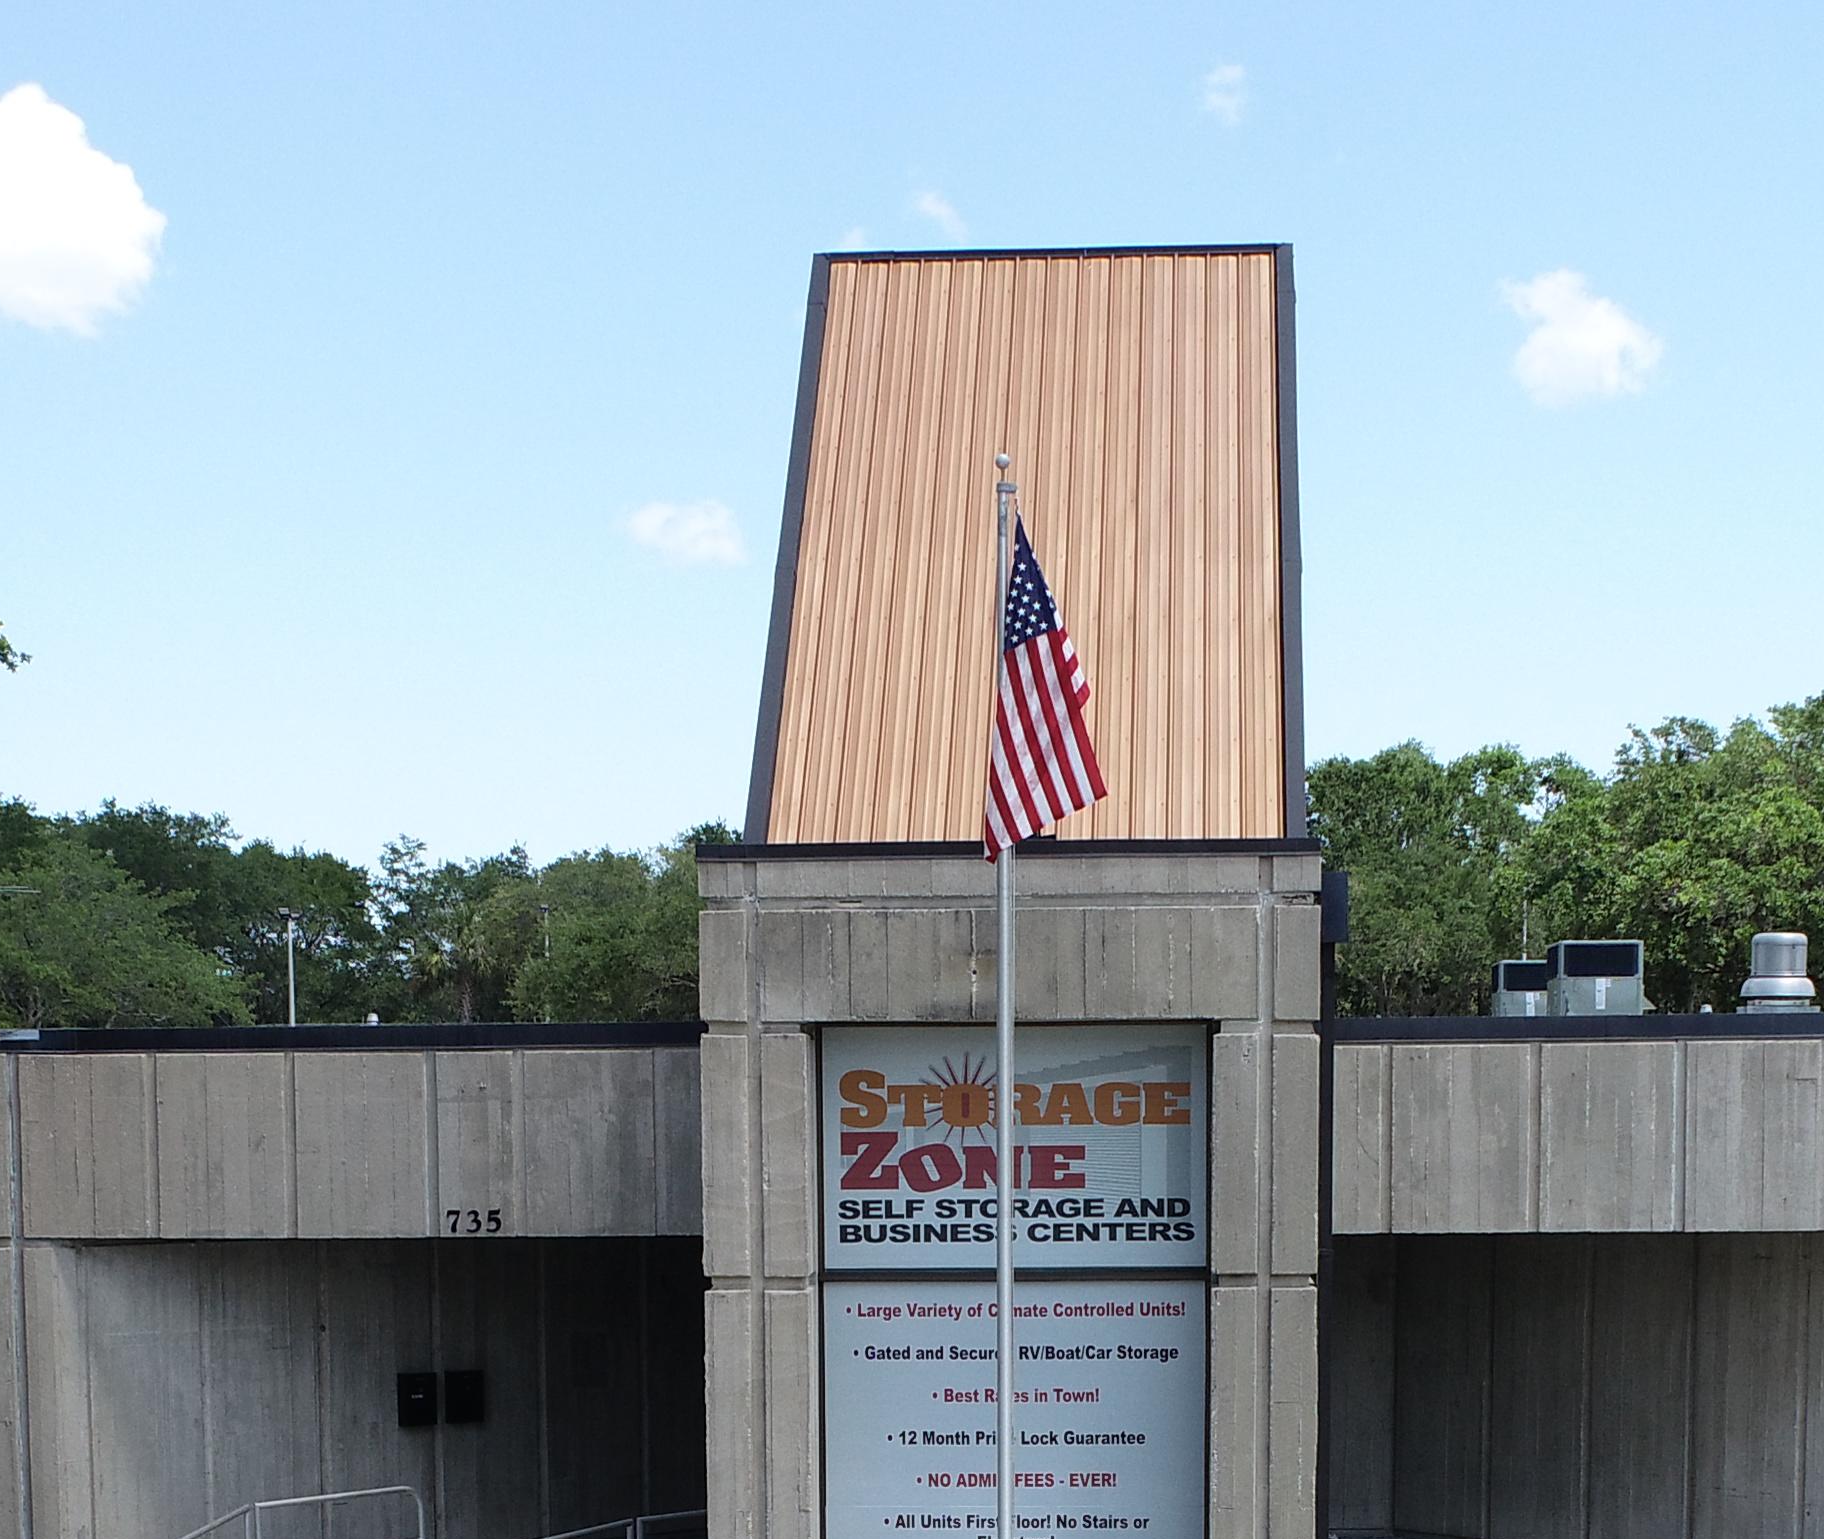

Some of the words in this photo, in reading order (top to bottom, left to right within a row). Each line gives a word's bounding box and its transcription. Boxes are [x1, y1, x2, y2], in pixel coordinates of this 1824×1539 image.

[839, 1069, 1192, 1128] STORAGE
[840, 1131, 1086, 1193] ZONE
[839, 1199, 925, 1220] SELF
[935, 1198, 1105, 1219] STORAGE
[1114, 1198, 1191, 1218] AND
[446, 1209, 502, 1233] 735
[1028, 1221, 1195, 1242] CENTERS
[858, 1303, 902, 1321] Large
[907, 1303, 963, 1321] Variety
[967, 1303, 984, 1318] of
[988, 1303, 1049, 1318] Cmate
[1053, 1301, 1135, 1318] Controlled
[1139, 1301, 1186, 1317] Units!
[864, 1345, 911, 1361] Gated
[916, 1346, 944, 1361] and
[1019, 1345, 1113, 1361] RV/Boat/Car
[1117, 1344, 1180, 1363] Storage
[944, 1388, 980, 1403] Best
[984, 1388, 1030, 1403] Res
[1035, 1388, 1049, 1403] in
[1052, 1388, 1100, 1403] Town!
[899, 1431, 918, 1446] 12
[922, 1431, 971, 1446] Month
[976, 1431, 1016, 1446] Pri
[1021, 1431, 1059, 1446] Lock
[1064, 1430, 1146, 1446] Guarantee
[928, 1473, 952, 1488] NO
[956, 1473, 998, 1488] ADMI
[1014, 1473, 1055, 1488] FEES
[1069, 1472, 1117, 1488] EVER!
[894, 1514, 916, 1529] All
[921, 1514, 962, 1529] Units
[1012, 1514, 1052, 1529] loor!
[1056, 1515, 1078, 1530] No
[1082, 1514, 1129, 1529] Stairs
[1133, 1518, 1150, 1529] or
